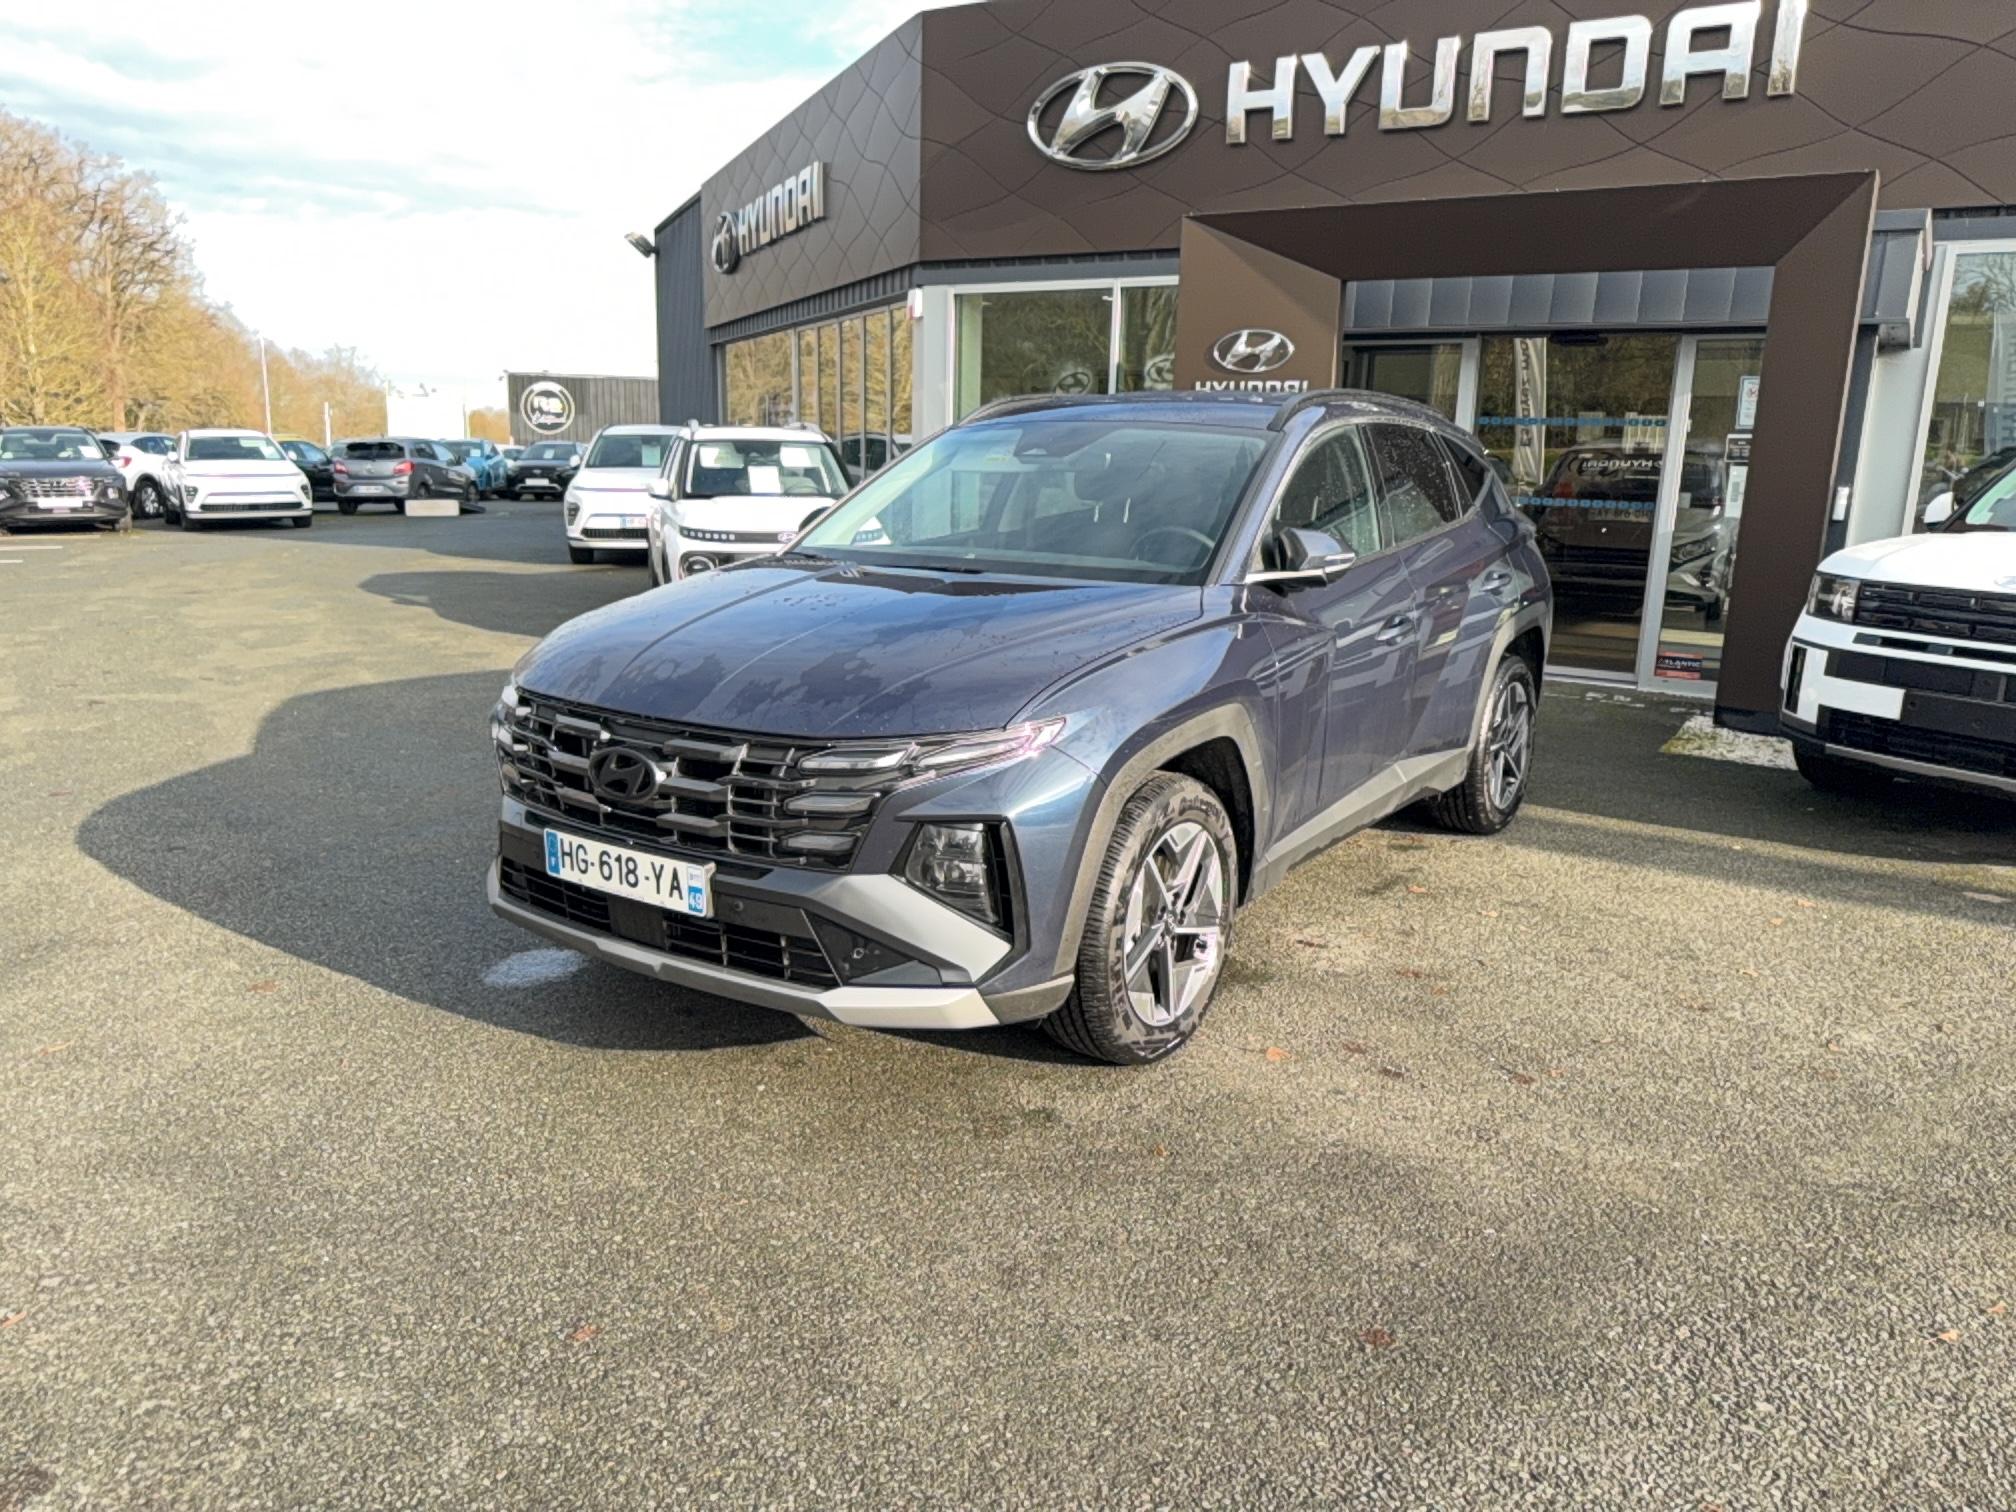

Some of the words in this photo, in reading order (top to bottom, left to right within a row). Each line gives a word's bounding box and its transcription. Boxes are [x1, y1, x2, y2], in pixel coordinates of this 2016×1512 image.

[1225, 0, 1808, 144] HYUNDAI
[738, 161, 825, 256] HYUNDAI
[561, 839, 683, 900] HG-618-YA
